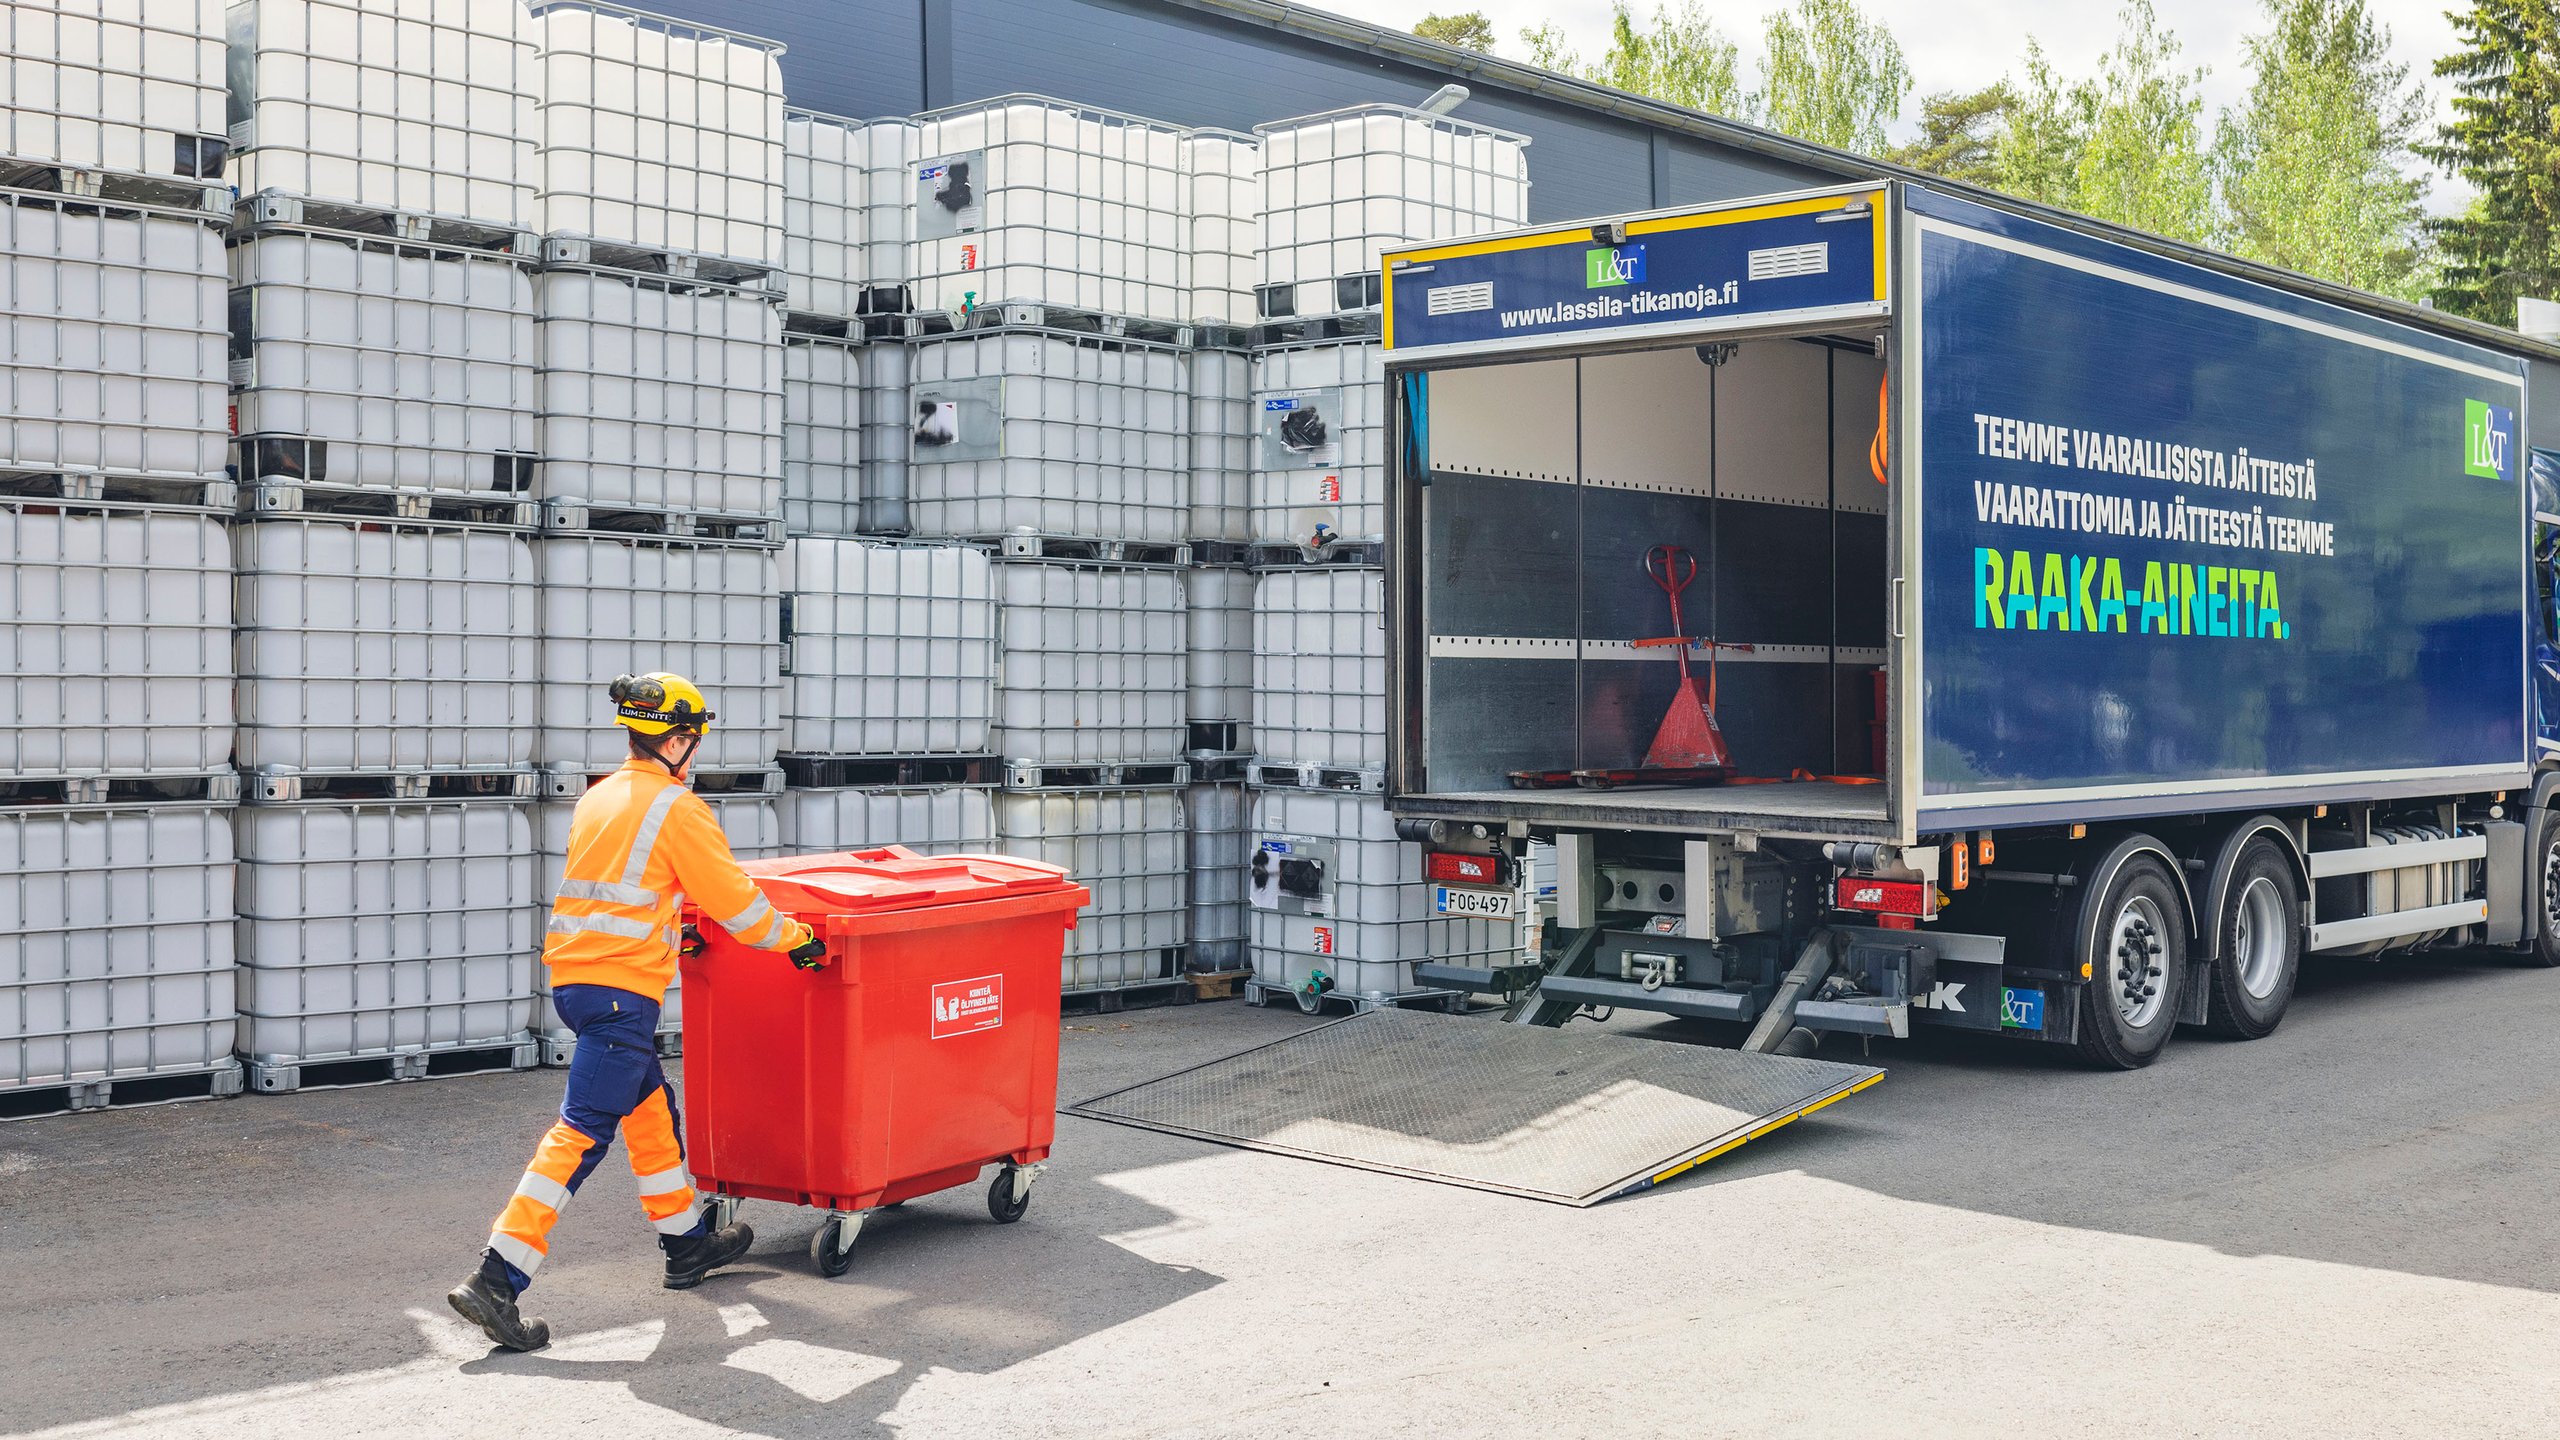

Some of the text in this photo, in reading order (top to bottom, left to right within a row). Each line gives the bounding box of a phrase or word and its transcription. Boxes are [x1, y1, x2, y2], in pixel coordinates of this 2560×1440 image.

[1596, 249, 1637, 283] L&T
[1501, 281, 1739, 329] www.lassila-tikanoja.fi
[1974, 413, 2317, 501] TEEMME VAARALLISISTA JÄTTEISTÄ
[2473, 408, 2507, 471] L&T
[1974, 480, 2334, 556] VAARATTOMIA JA JÄTTEESTÄ TEEMME
[1975, 547, 2290, 640] RAAKA-AINEITA.
